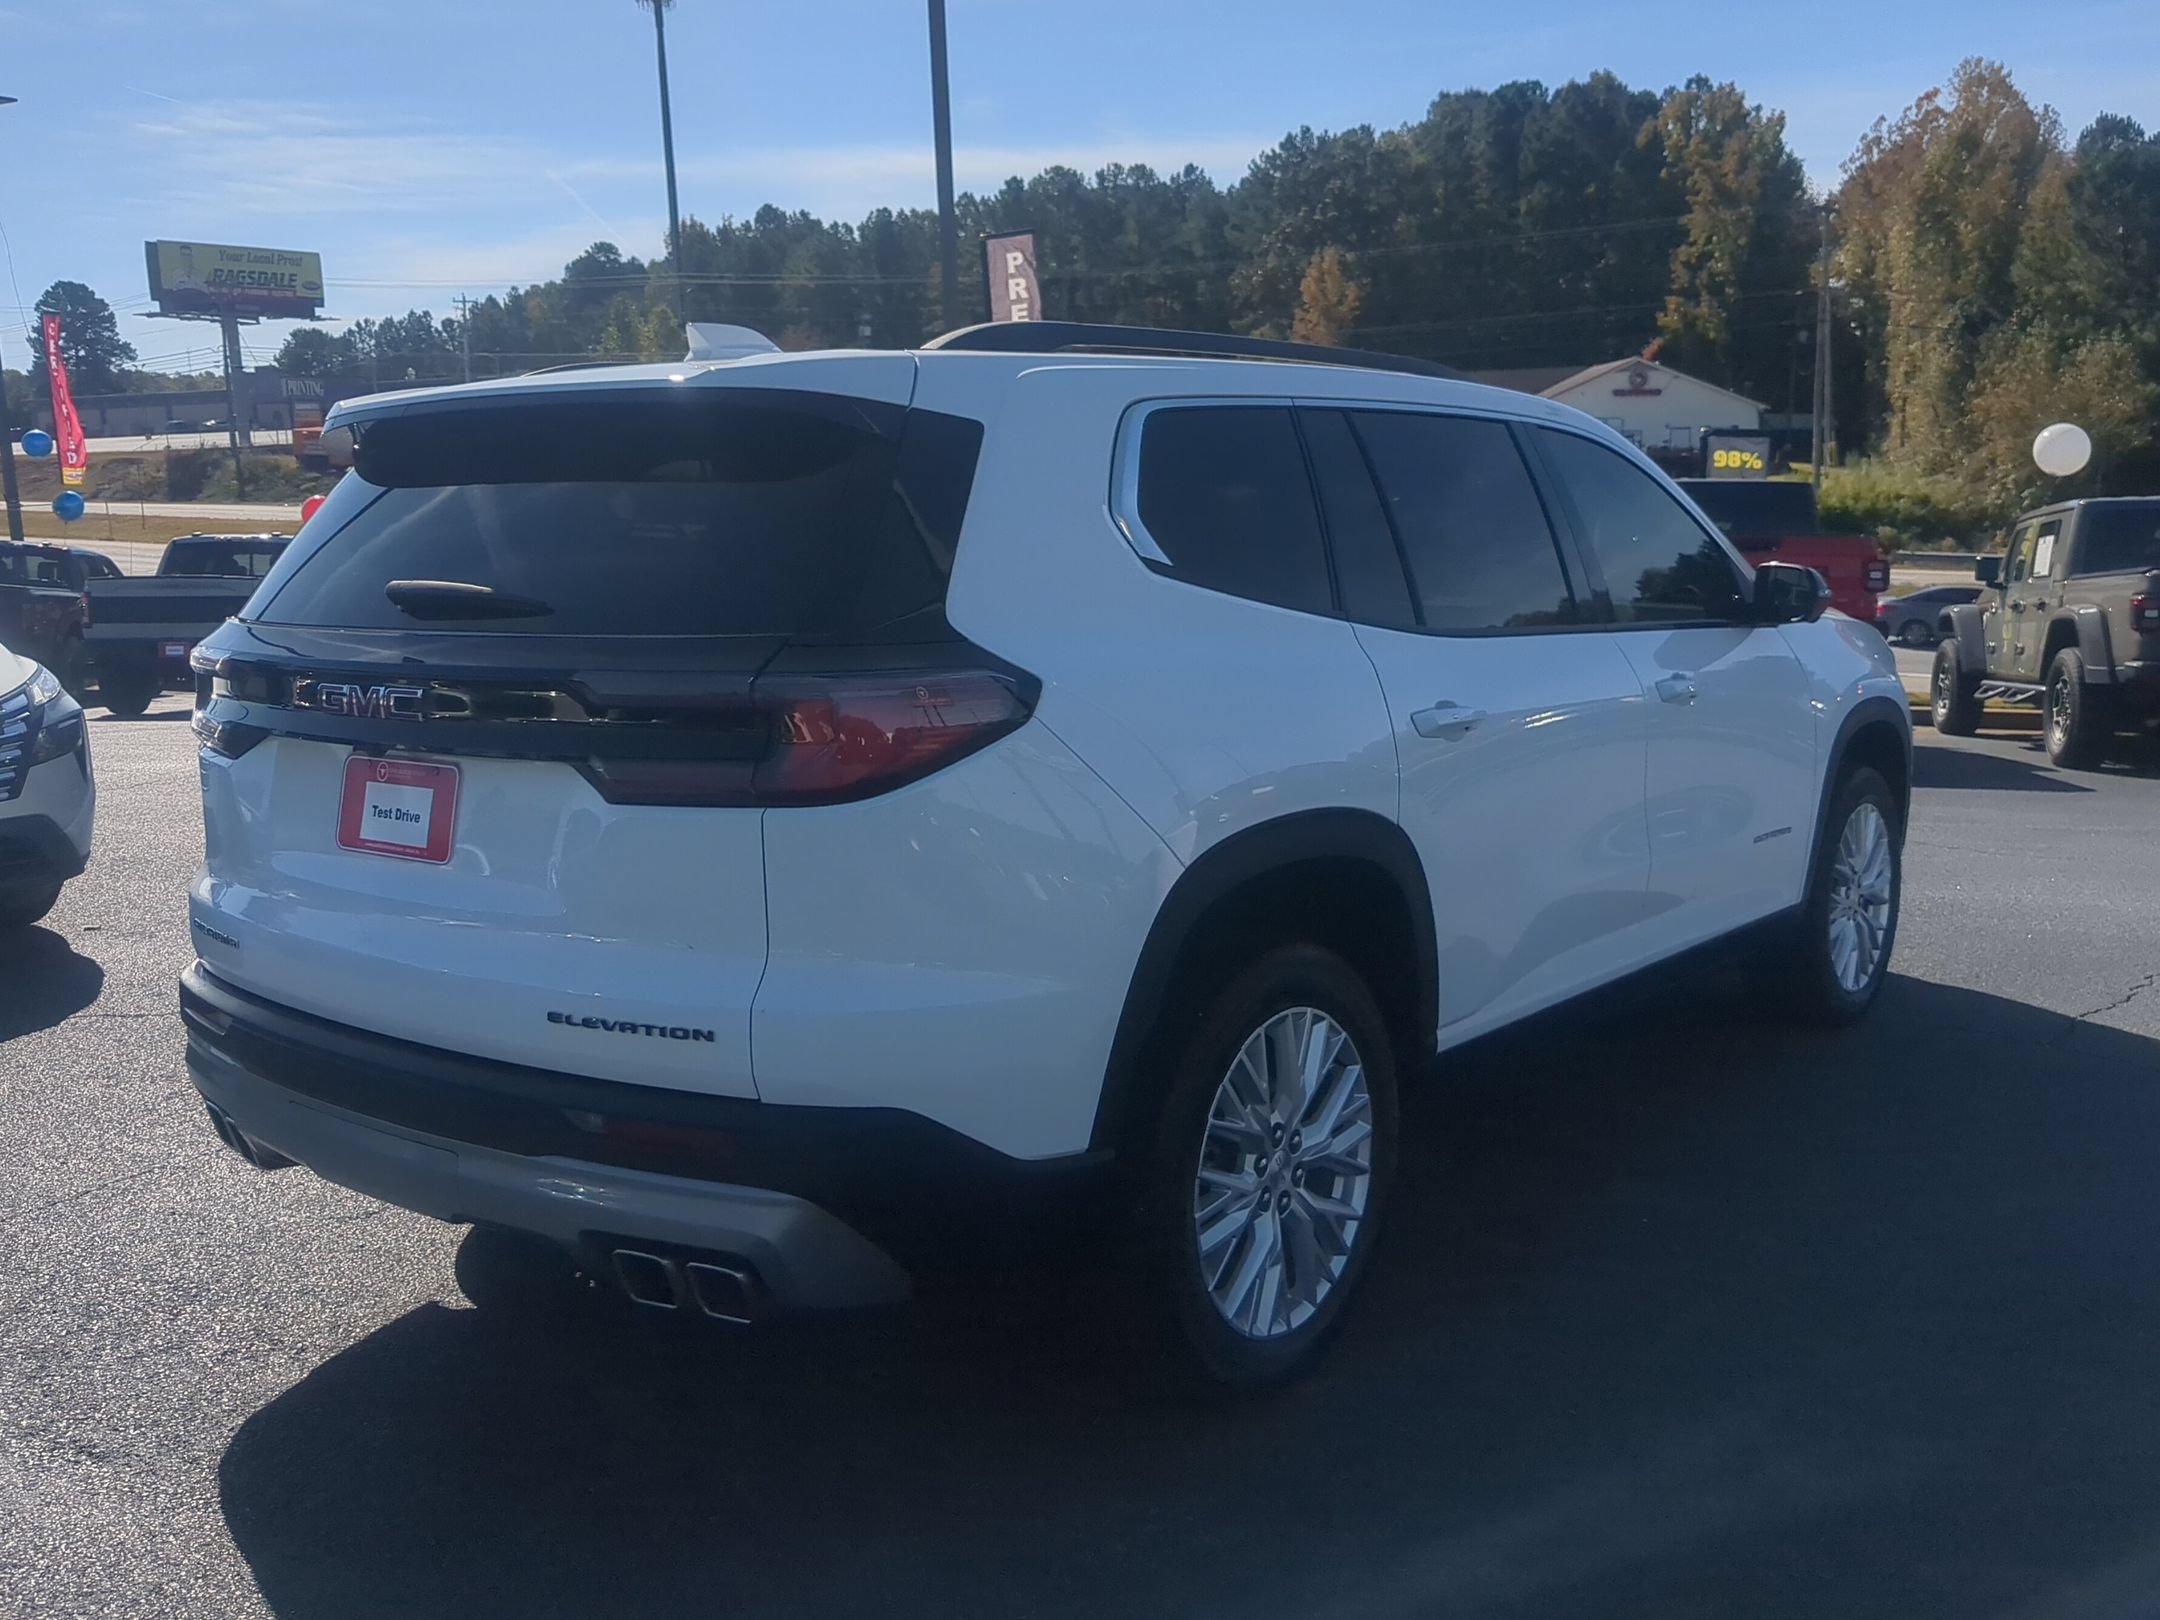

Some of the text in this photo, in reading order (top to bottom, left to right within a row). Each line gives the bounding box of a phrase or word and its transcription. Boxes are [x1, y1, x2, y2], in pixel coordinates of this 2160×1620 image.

[218, 249, 245, 263] Your
[246, 251, 275, 265] Local
[211, 267, 298, 288] RAGSDALE
[1006, 251, 1030, 321] PRE
[287, 379, 324, 397] PRINTING
[1712, 449, 1763, 470] 98%
[317, 682, 423, 722] GMC
[372, 804, 421, 824] Test Drive
[546, 1011, 716, 1043] ELEVATION
